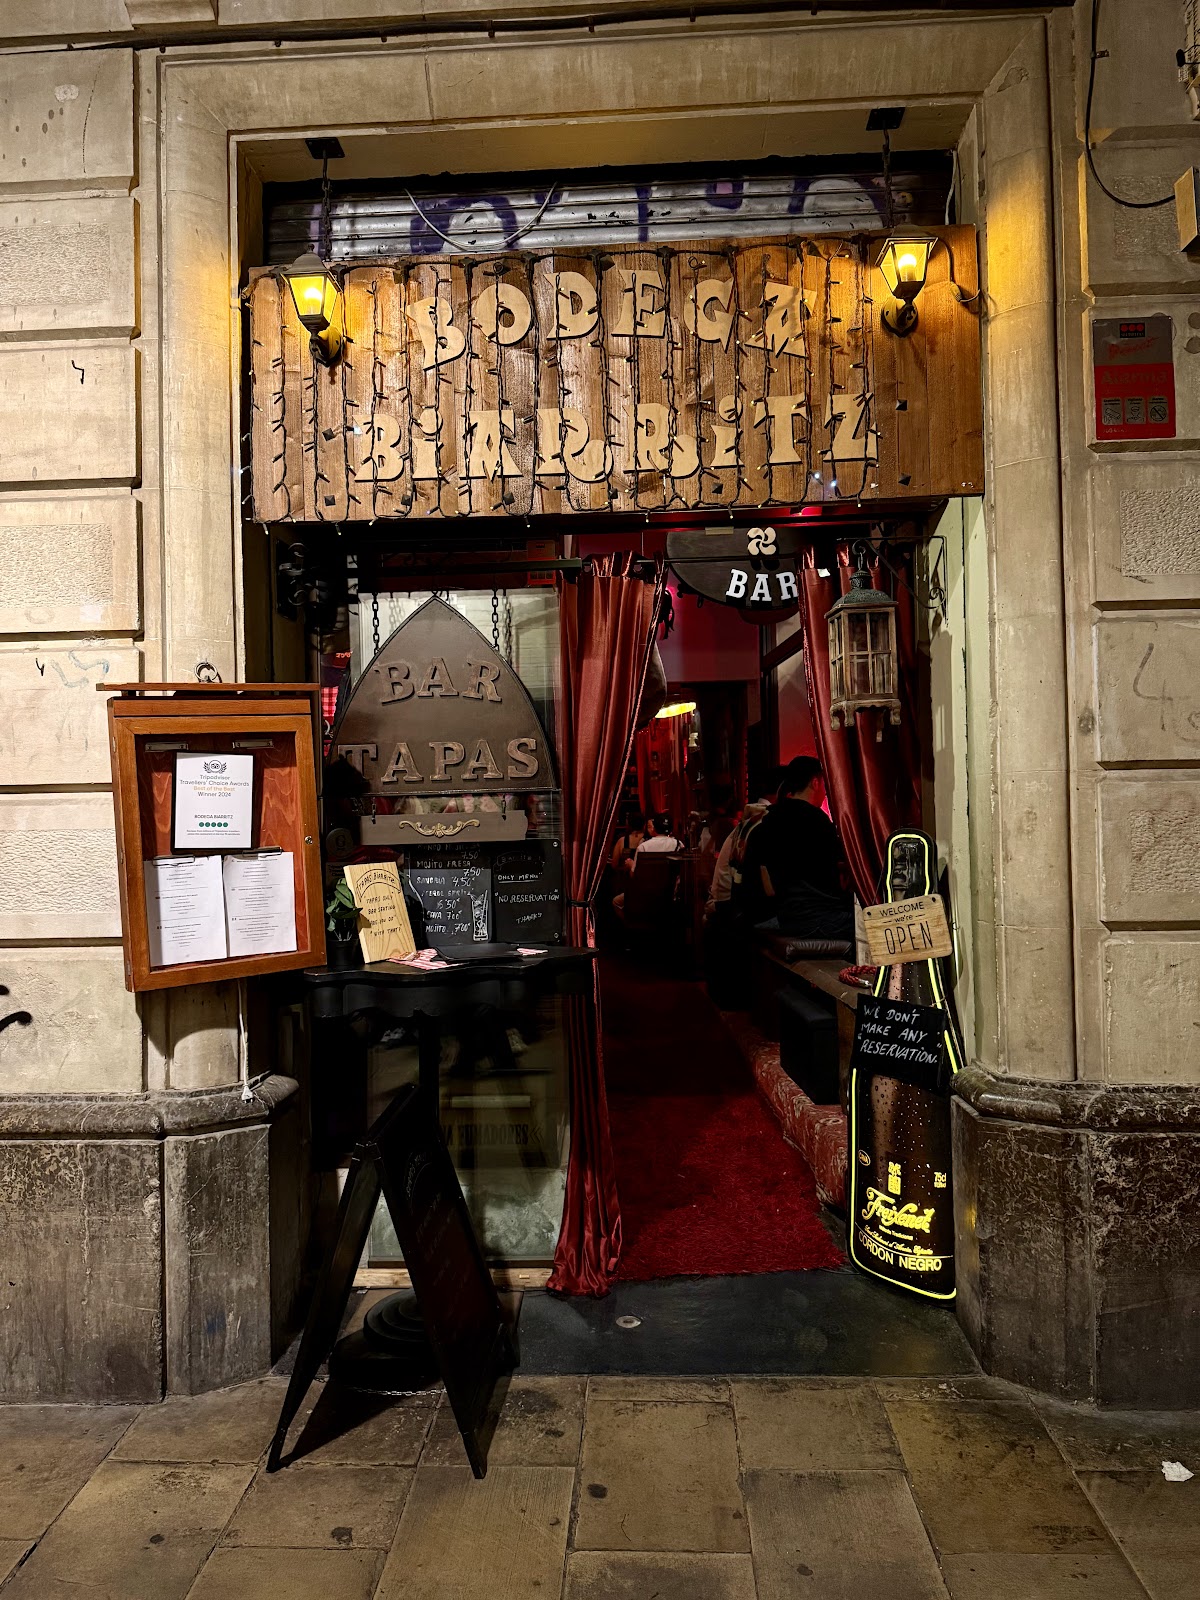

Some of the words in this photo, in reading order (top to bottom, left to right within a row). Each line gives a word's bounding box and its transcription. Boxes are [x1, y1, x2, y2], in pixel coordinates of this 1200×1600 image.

[405, 270, 818, 371] BODEGA
[725, 568, 799, 602] BAR
[373, 656, 502, 706] BAR
[338, 737, 540, 783] TAPAS
[446, 860, 471, 868] FRESA
[879, 901, 925, 917] WELCOME
[893, 914, 914, 923] we're
[884, 920, 934, 955] OPEN
[863, 1004, 880, 1019] WE
[885, 1008, 920, 1025] DON'T
[861, 1022, 892, 1036] MAKE
[900, 1027, 928, 1045] ANY
[858, 1230, 894, 1266] CORDON
[898, 1255, 943, 1272] NEGRO
